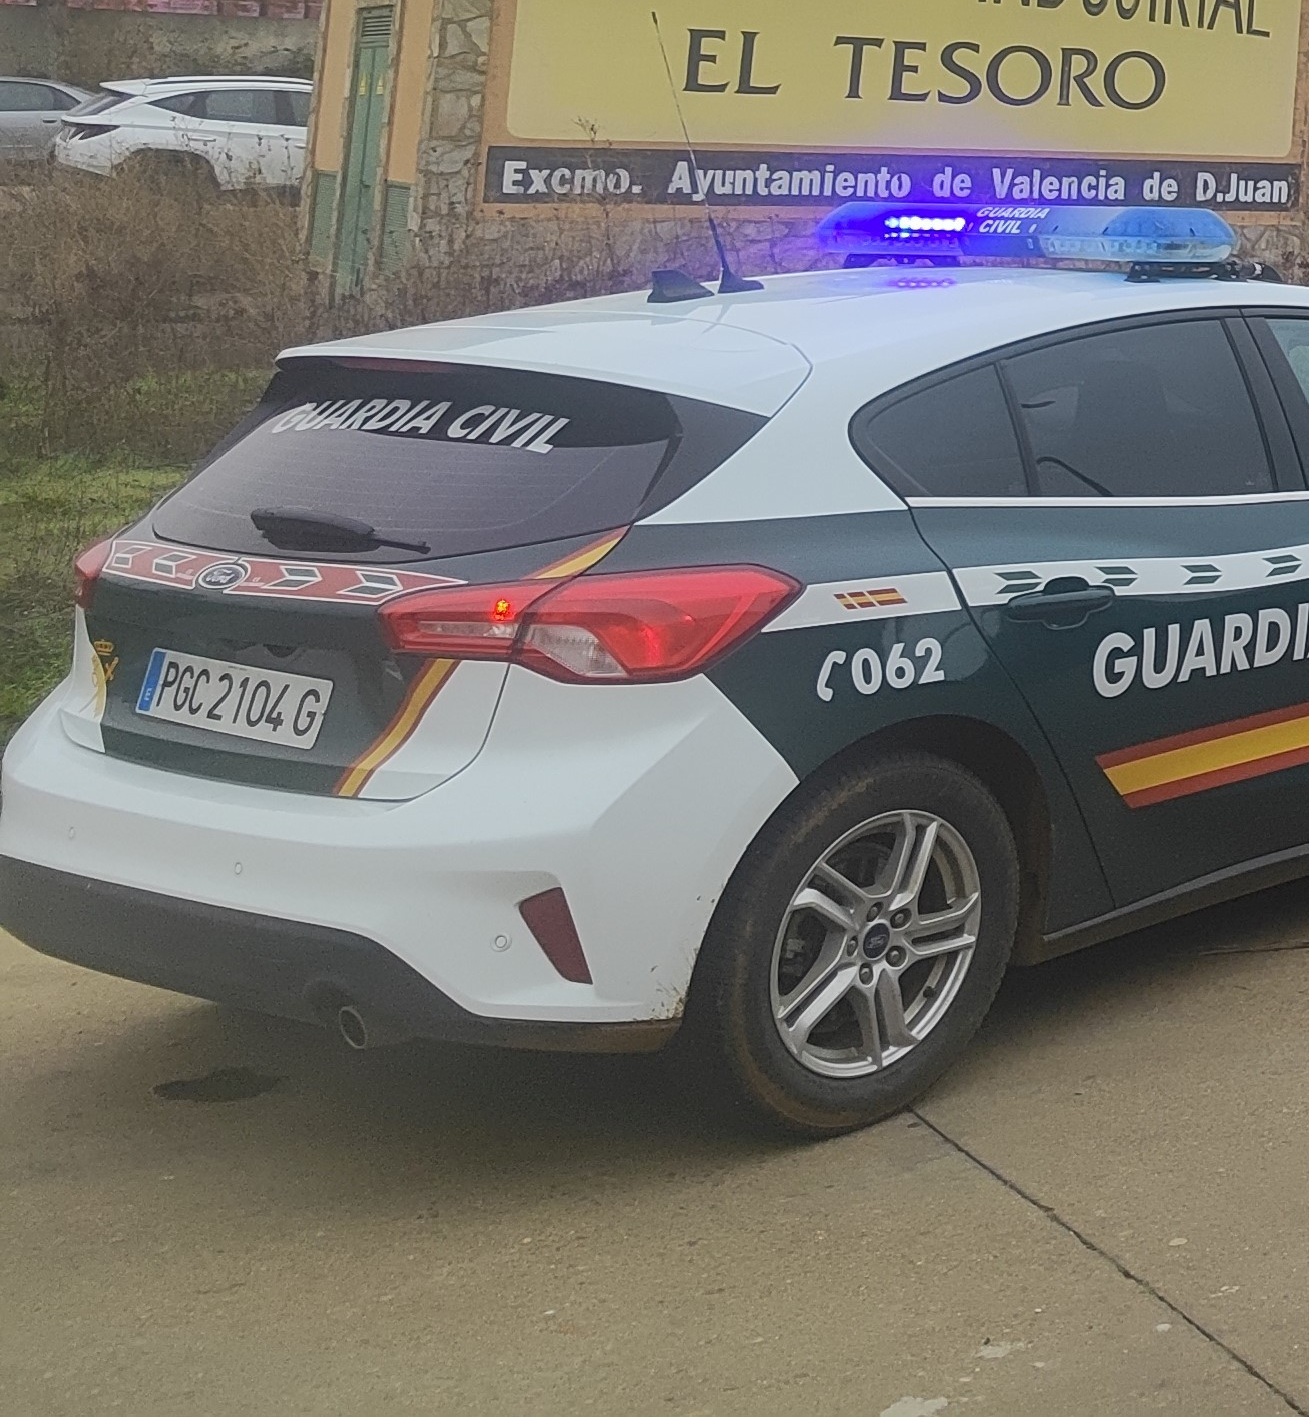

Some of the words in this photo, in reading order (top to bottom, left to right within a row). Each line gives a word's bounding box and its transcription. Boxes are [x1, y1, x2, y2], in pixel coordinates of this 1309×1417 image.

[683, 28, 781, 95] EL
[833, 35, 1167, 110] TESORO
[503, 160, 642, 197] Excmo.
[667, 161, 911, 202] Ayuntamiento
[932, 167, 972, 198] de
[991, 167, 1126, 201] Valencia
[1143, 170, 1179, 203] de
[1195, 171, 1290, 205] D.Juan
[976, 206, 1051, 219] GUARDIA
[978, 219, 1022, 234] CIVIL
[272, 399, 452, 434] GUARDIA
[447, 404, 570, 454] CIVIL
[851, 637, 945, 695] 062
[156, 661, 210, 715] PGC
[206, 672, 290, 732] 2104
[293, 688, 321, 736] G
